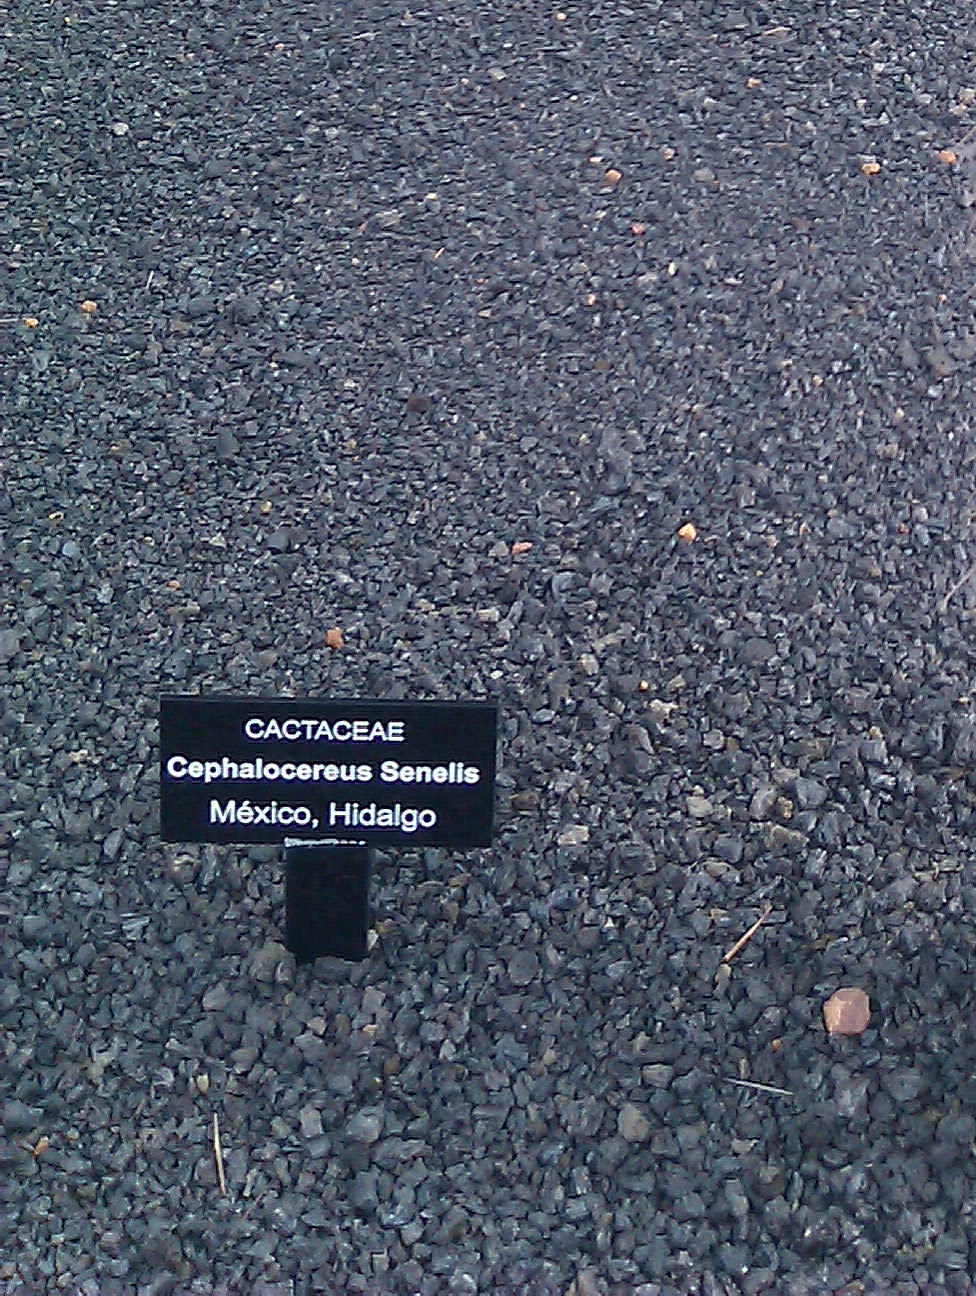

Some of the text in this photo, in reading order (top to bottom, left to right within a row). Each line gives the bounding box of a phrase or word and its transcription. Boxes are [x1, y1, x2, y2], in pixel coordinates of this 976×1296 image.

[244, 718, 405, 742] CACTACEAE
[166, 755, 480, 784] Cephalocereus Senelis
[209, 799, 437, 832] México, Hidalgo
